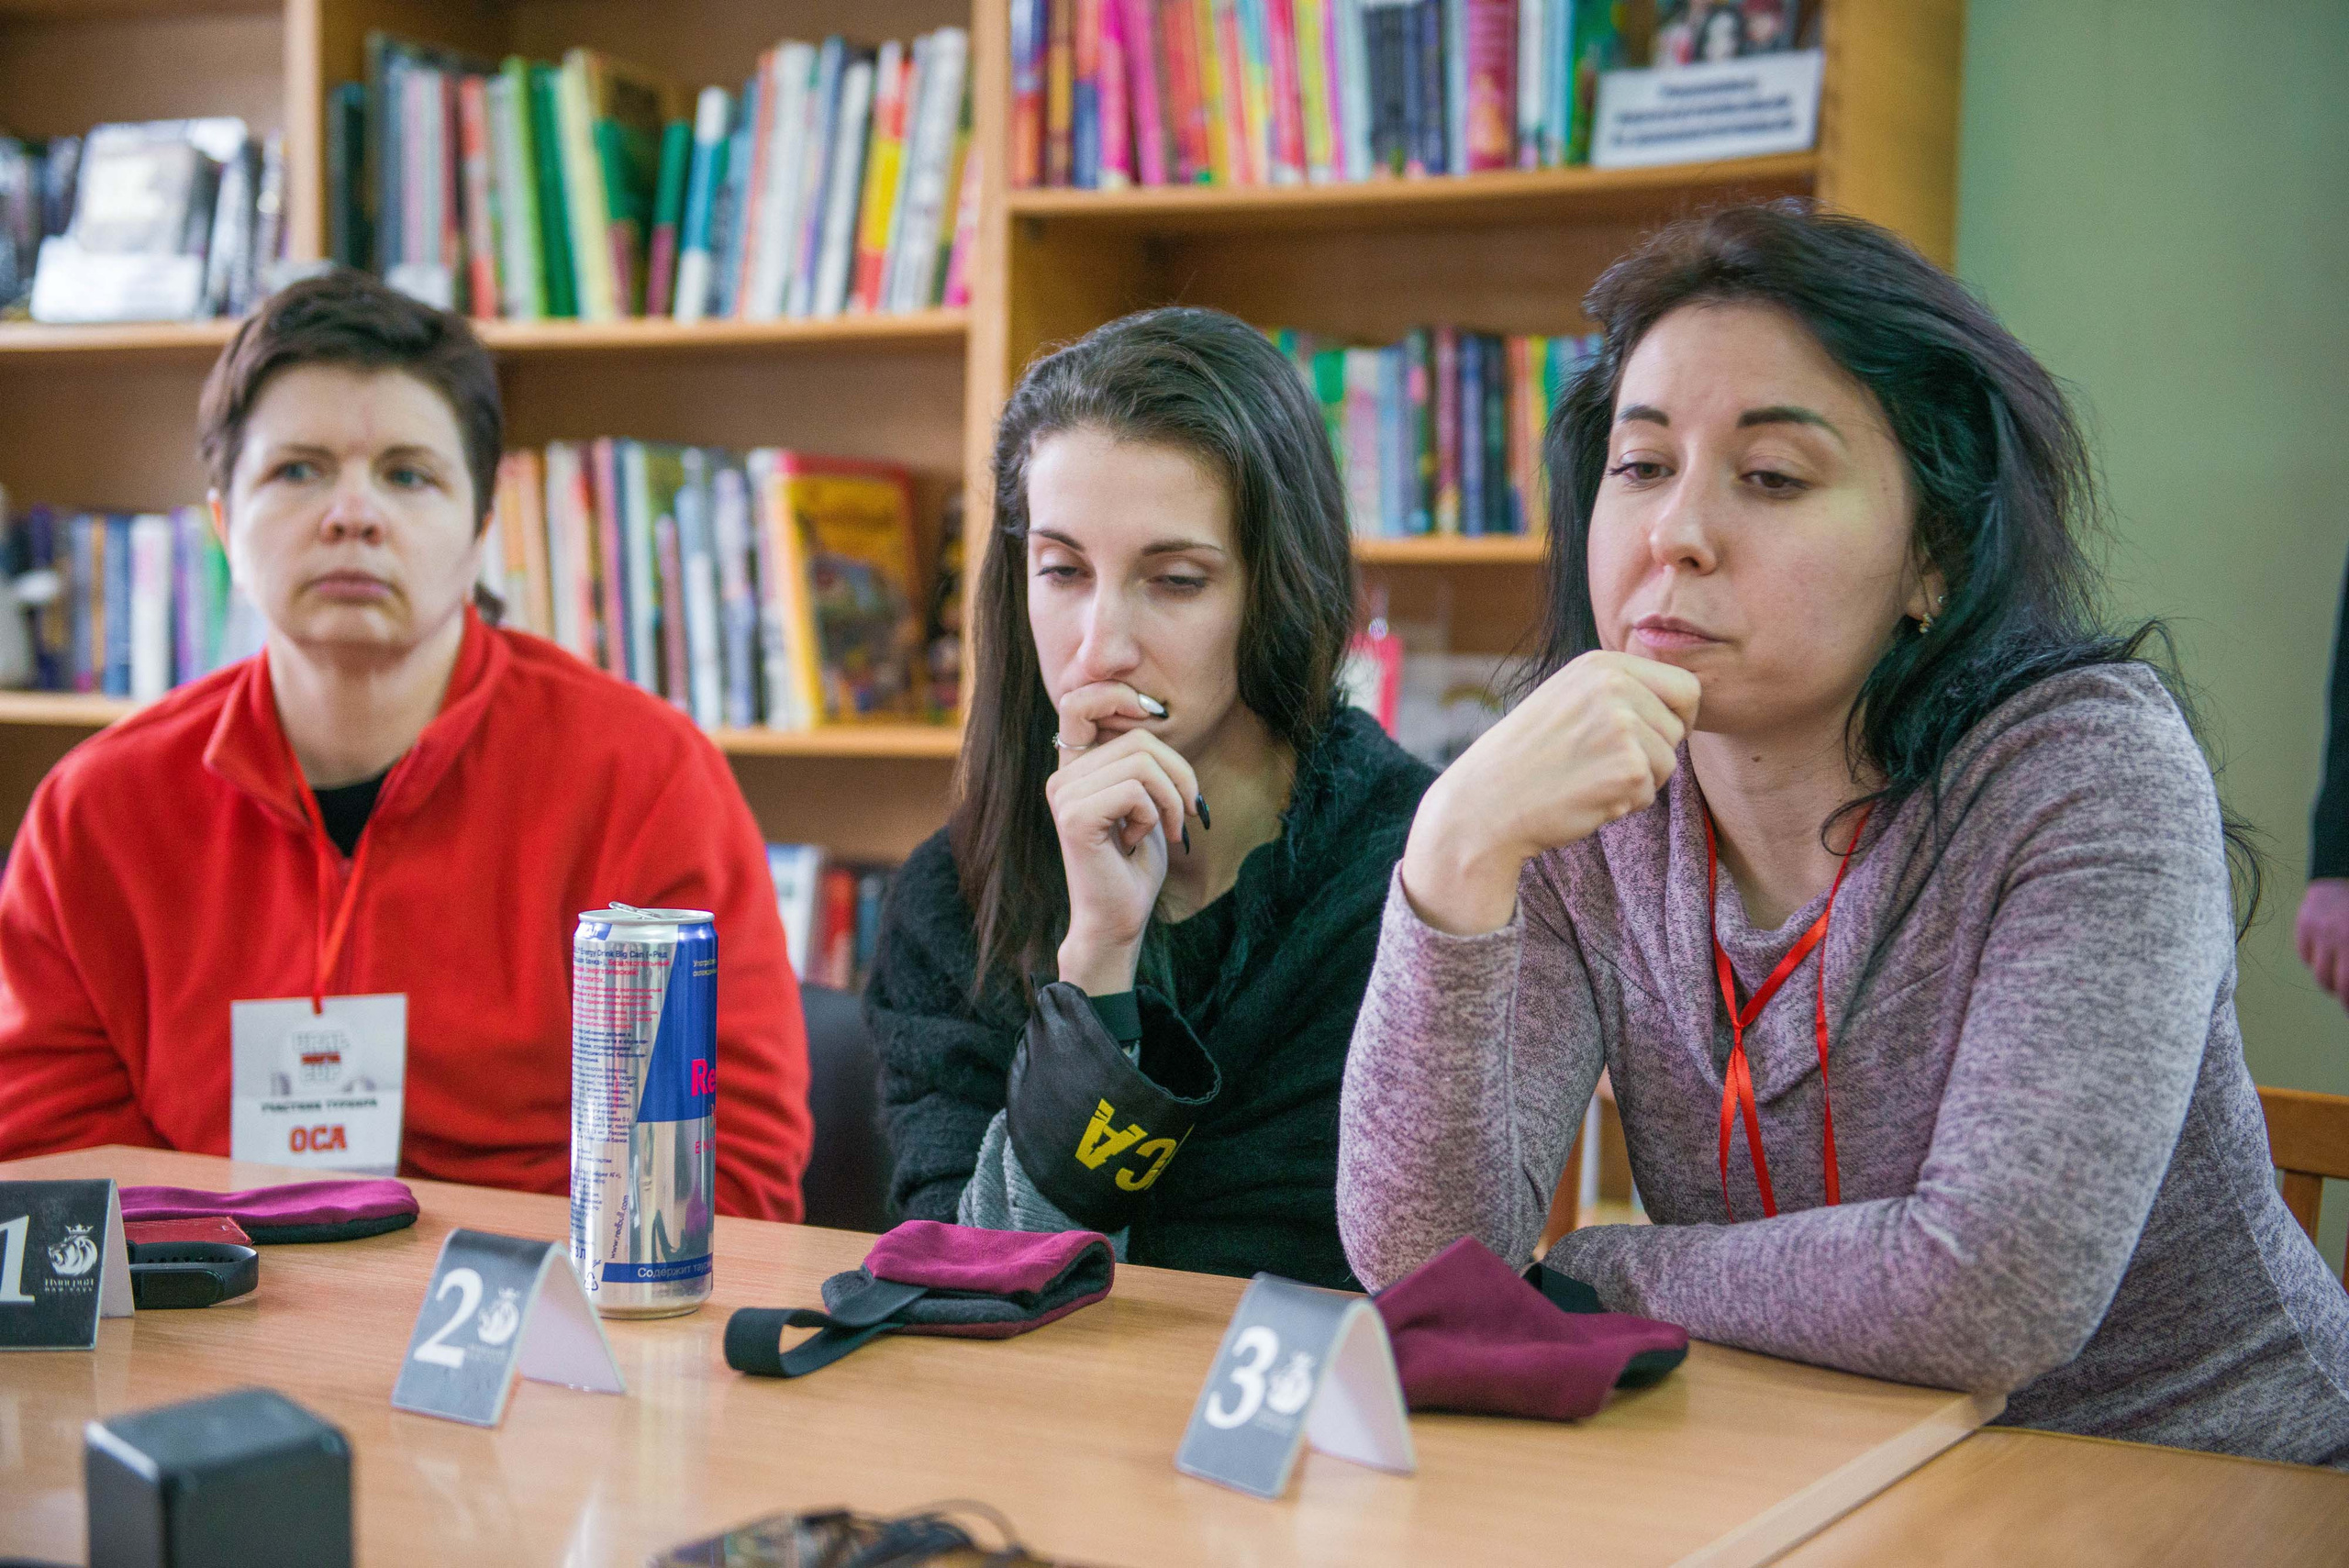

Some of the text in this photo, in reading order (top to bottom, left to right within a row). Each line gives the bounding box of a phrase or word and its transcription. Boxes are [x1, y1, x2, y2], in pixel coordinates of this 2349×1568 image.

[597, 950, 614, 958] Drink
[616, 951, 627, 960] Big
[629, 951, 643, 959] Can
[289, 1123, 348, 1152] ОСА
[1074, 1098, 1184, 1192] СА
[0, 1215, 35, 1303] 1
[610, 1195, 629, 1260] www.redbull.com
[637, 1263, 692, 1279] Содержит
[414, 1267, 484, 1369] 2
[1204, 1325, 1279, 1429] 3
